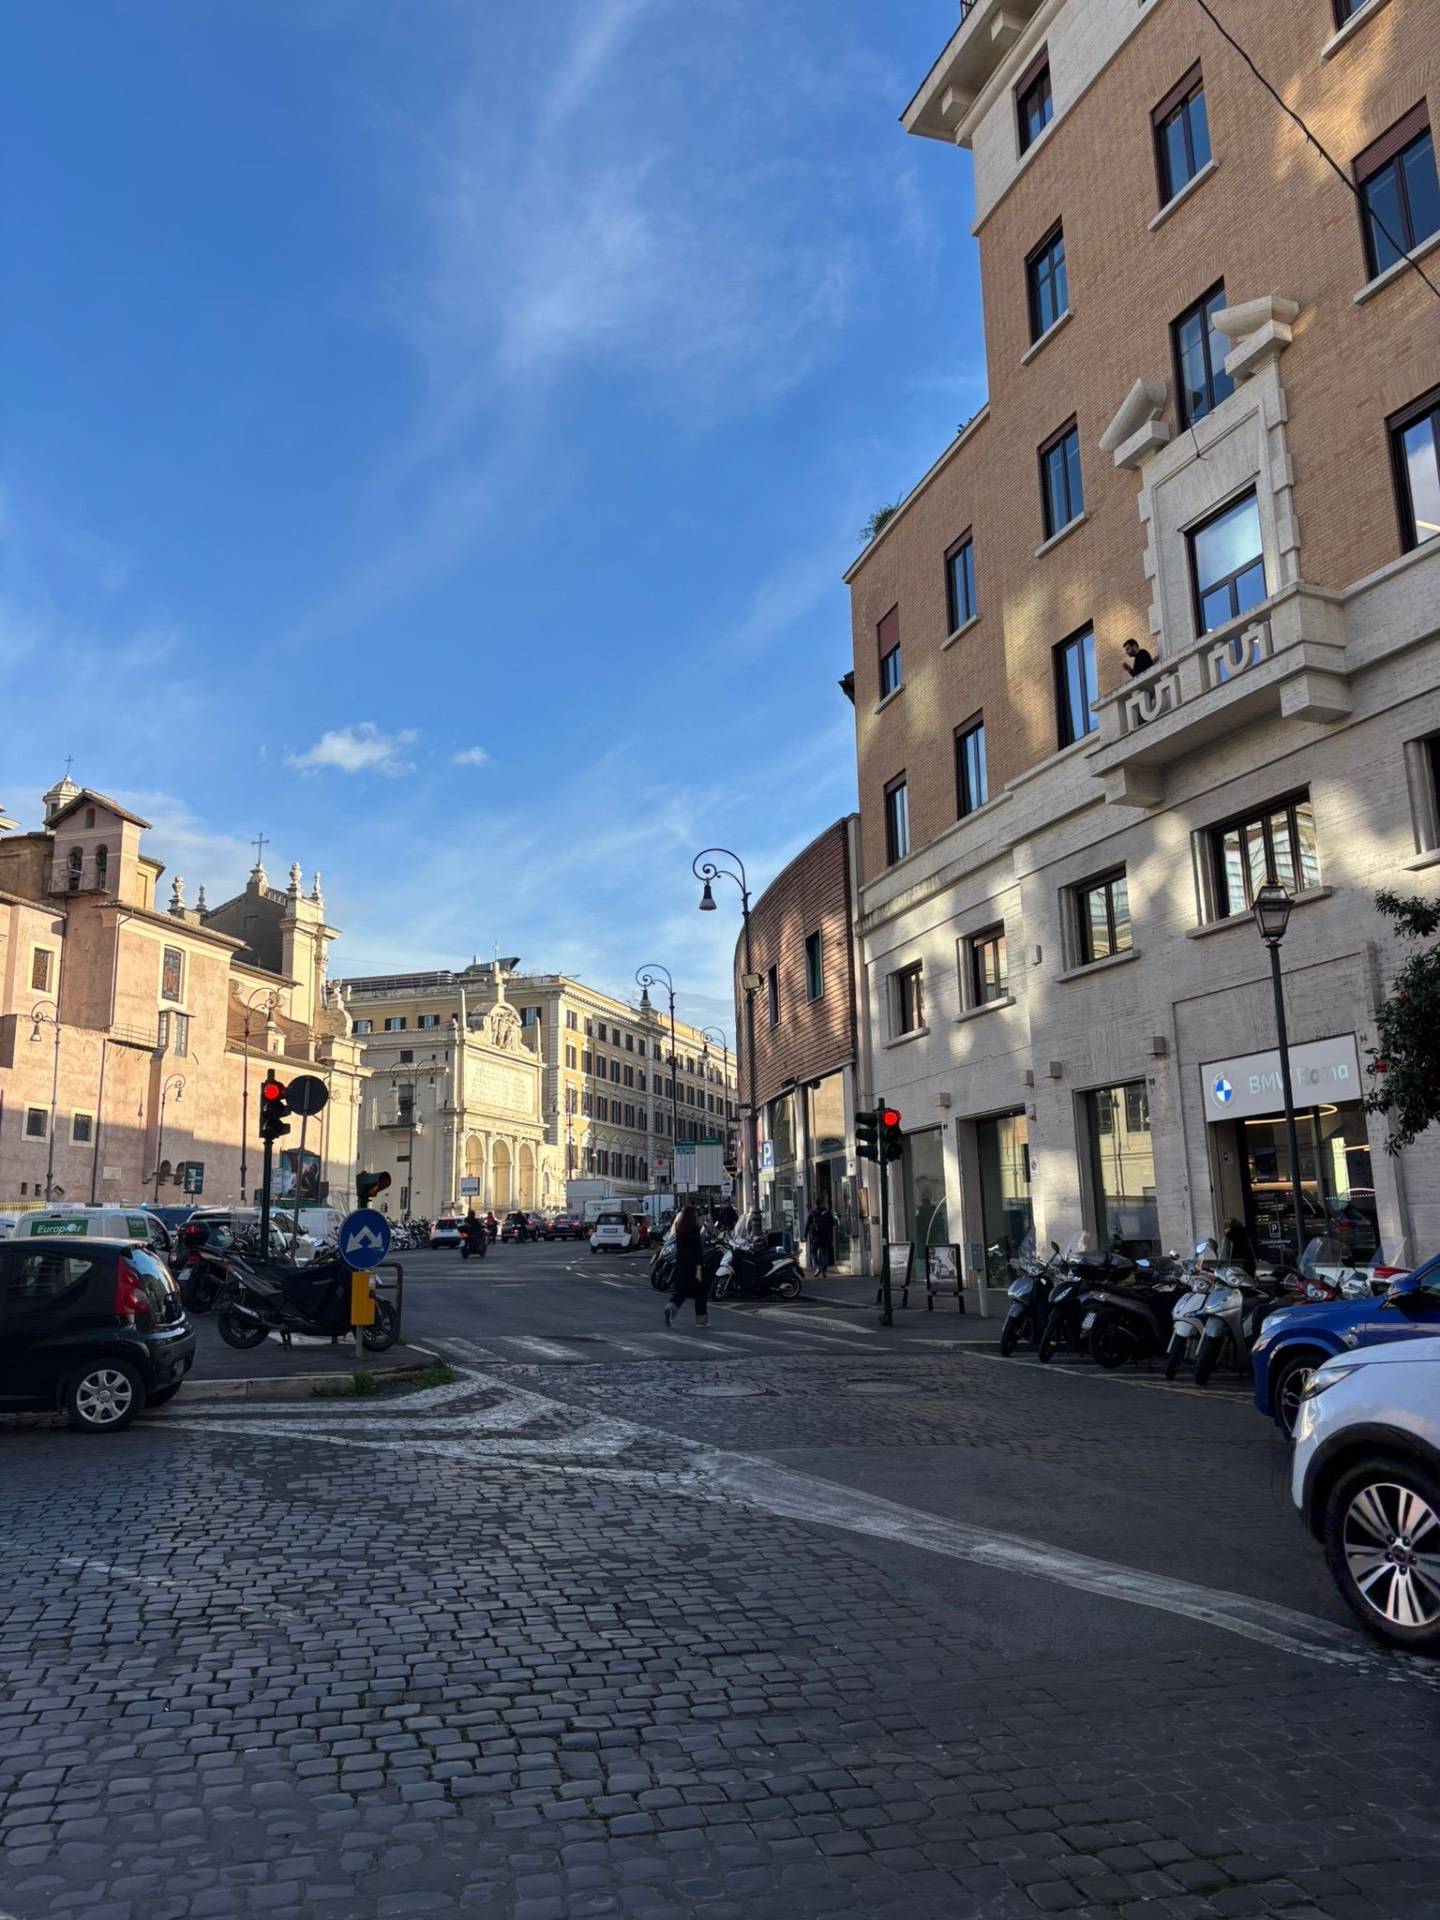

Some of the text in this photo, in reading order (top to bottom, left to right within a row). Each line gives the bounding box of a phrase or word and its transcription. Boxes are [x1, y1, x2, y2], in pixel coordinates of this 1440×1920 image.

[1295, 1065, 1349, 1087] Roma
[763, 1143, 771, 1166] P
[36, 1223, 82, 1235] Europr
